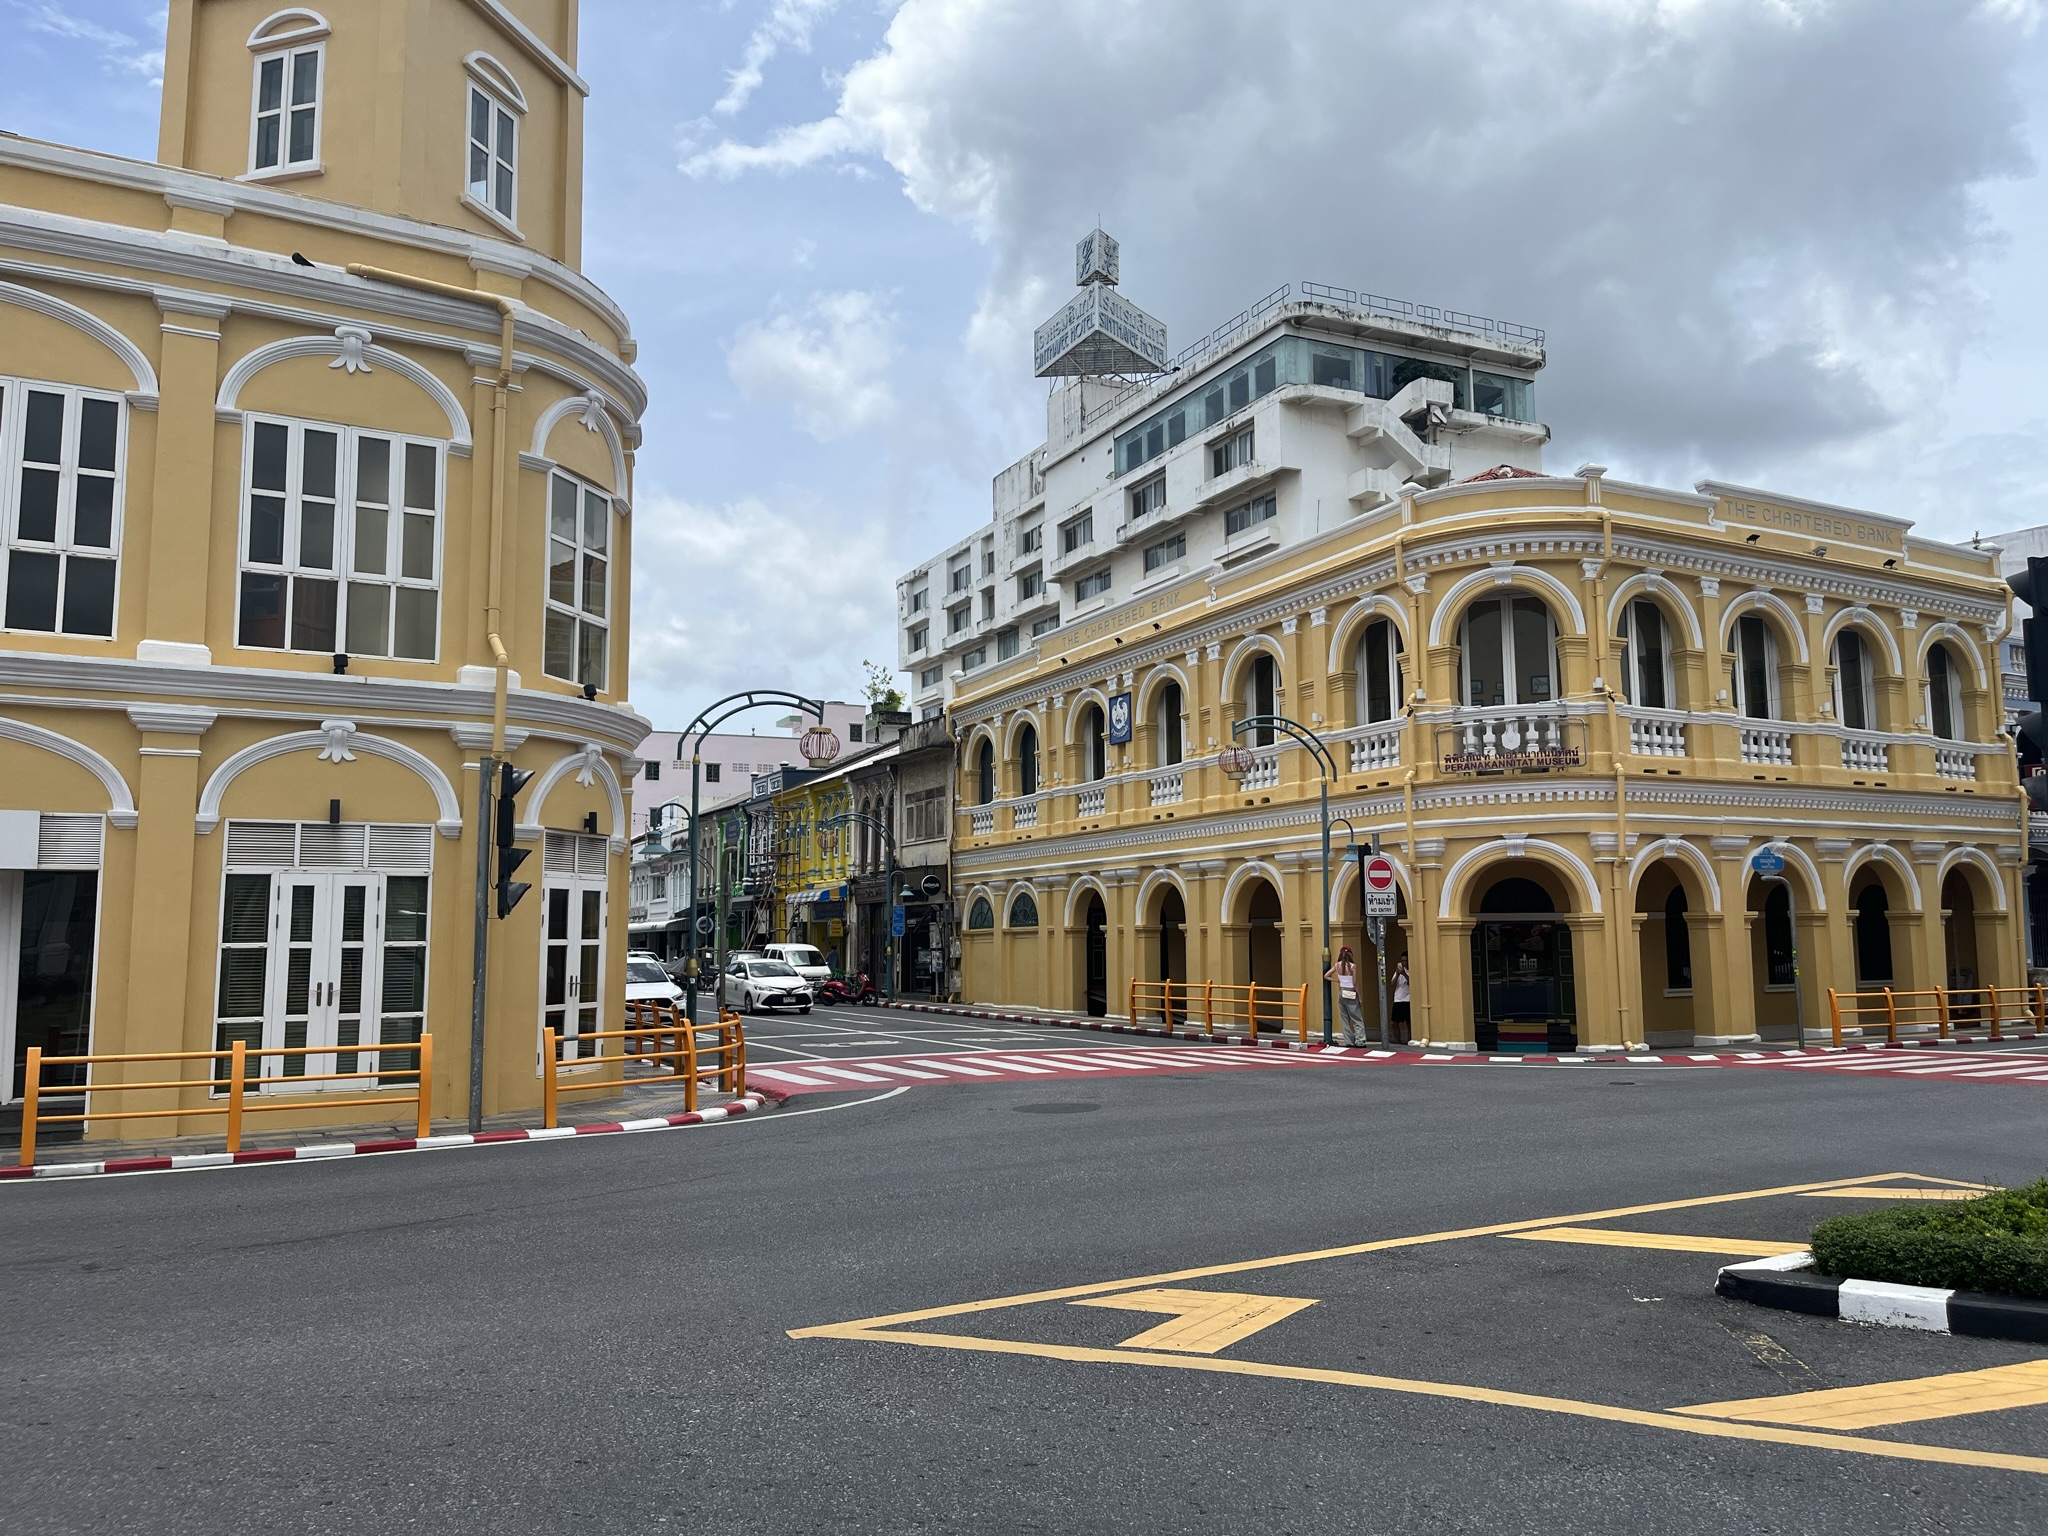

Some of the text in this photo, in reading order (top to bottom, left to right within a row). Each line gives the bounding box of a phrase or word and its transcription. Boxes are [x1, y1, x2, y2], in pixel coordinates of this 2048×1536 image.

[1070, 312, 1095, 344] HOTEL
[1140, 339, 1164, 365] HOTEL
[1725, 500, 1894, 545] THE CHARTERED BANK
[1062, 591, 1181, 648] THE CHARTERED BANK
[1444, 749, 1491, 764] พิพิธภัณฑ์
[1444, 757, 1580, 772] PERANAKANNITAT MUSEUM
[1368, 894, 1395, 905] ห้ามเข้า
